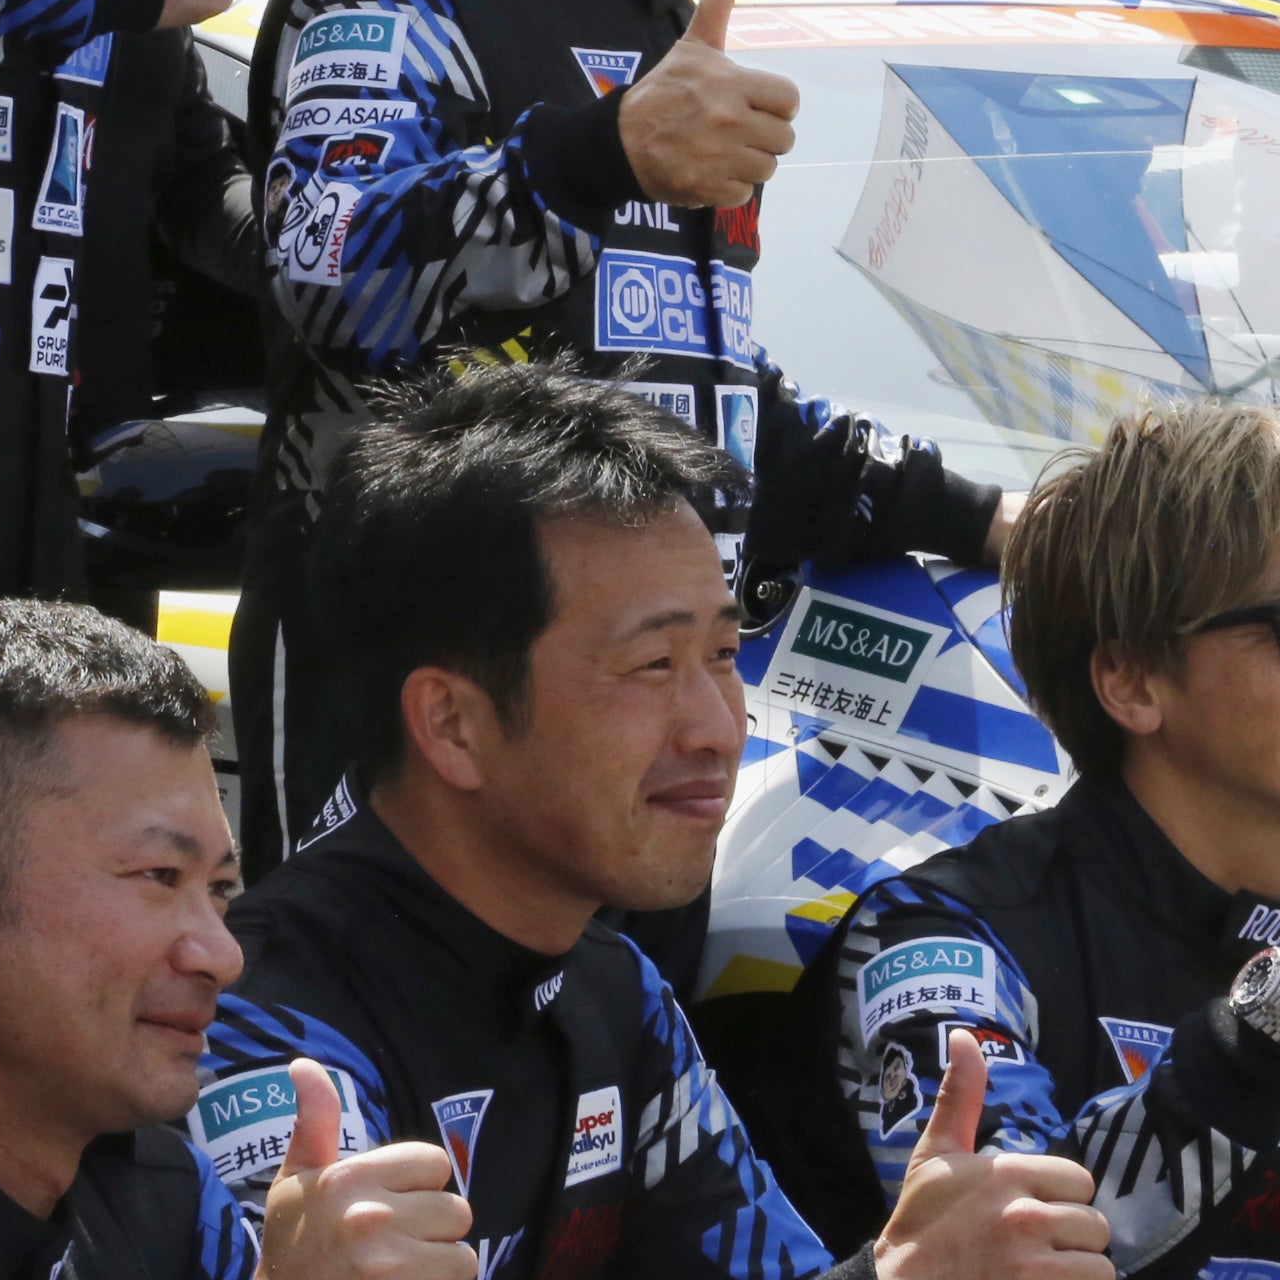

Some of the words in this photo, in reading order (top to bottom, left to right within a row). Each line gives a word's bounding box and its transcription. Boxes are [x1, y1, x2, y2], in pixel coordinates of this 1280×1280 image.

[300, 23, 385, 56] MS&AD
[804, 7, 1163, 41] ENEOS
[587, 55, 626, 68] SPARX
[289, 62, 388, 96] 三井住友海上
[284, 107, 331, 131] AERO
[807, 616, 914, 669] MS&AD
[771, 672, 895, 727] 三井住友海上
[872, 949, 973, 989] MS&AD
[865, 984, 984, 1035] 三井住友海上
[1118, 1024, 1162, 1042] SPARX
[210, 1083, 297, 1126] MS&
[442, 1100, 473, 1120] SPARX
[574, 1109, 615, 1136] uper
[213, 1127, 358, 1177] 三井住上
